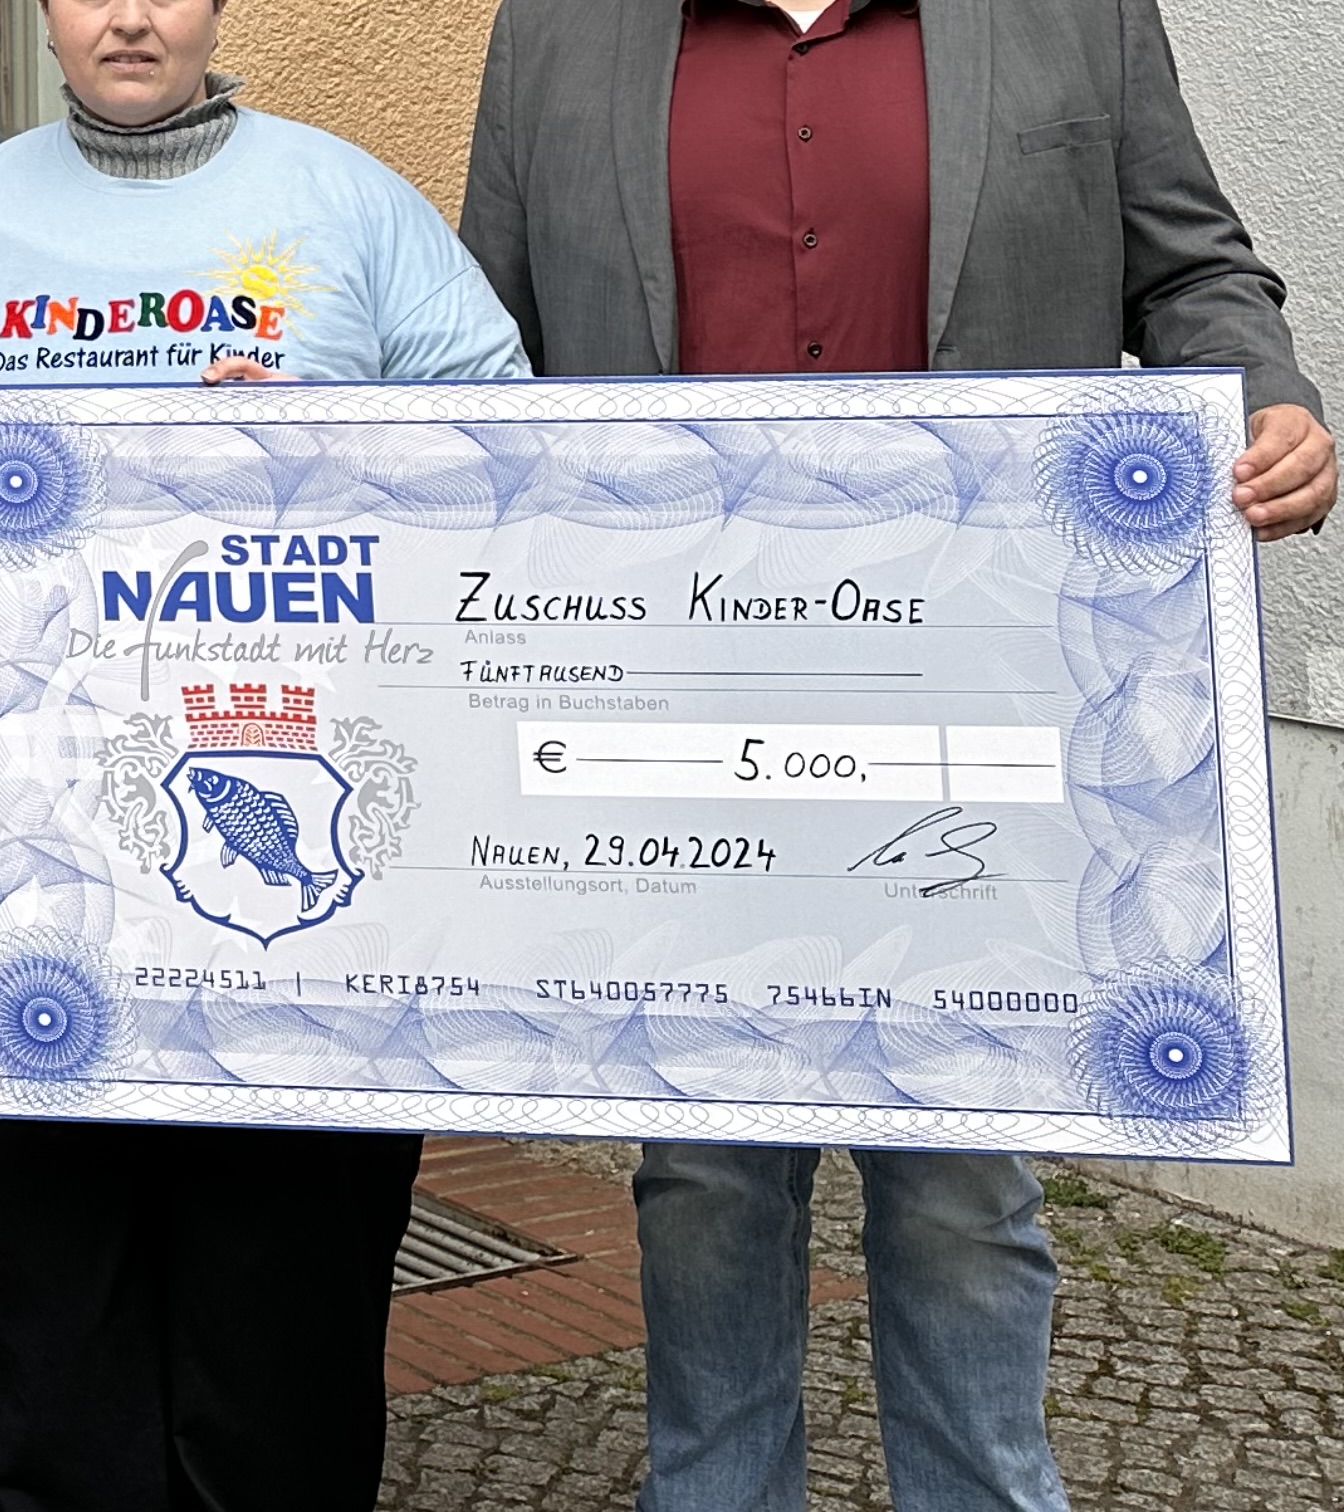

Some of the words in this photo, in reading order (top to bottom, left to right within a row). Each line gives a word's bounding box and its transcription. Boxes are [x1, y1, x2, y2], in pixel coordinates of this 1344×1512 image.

[0, 289, 285, 341] KINDEROASE
[36, 344, 158, 370] Restaurant
[166, 342, 202, 366] für
[221, 534, 380, 566] STADT
[102, 571, 375, 623] NAUEN
[66, 627, 117, 660] Die
[295, 636, 347, 665] mit
[364, 628, 434, 665] Herz
[465, 629, 527, 646] Anlass
[468, 694, 529, 713] Betrag
[536, 695, 552, 710] in
[558, 695, 669, 712] Buchstaben
[532, 739, 568, 774] €
[584, 834, 776, 873] 29.04.2024
[479, 874, 629, 898] Ausstellungsort,
[636, 877, 697, 895] Datum
[883, 881, 999, 901] Unterschrift
[134, 966, 266, 990] 22224511
[345, 973, 480, 997] KERI8754
[536, 978, 728, 1004] ST640057775
[933, 989, 1078, 1014] 54000000
